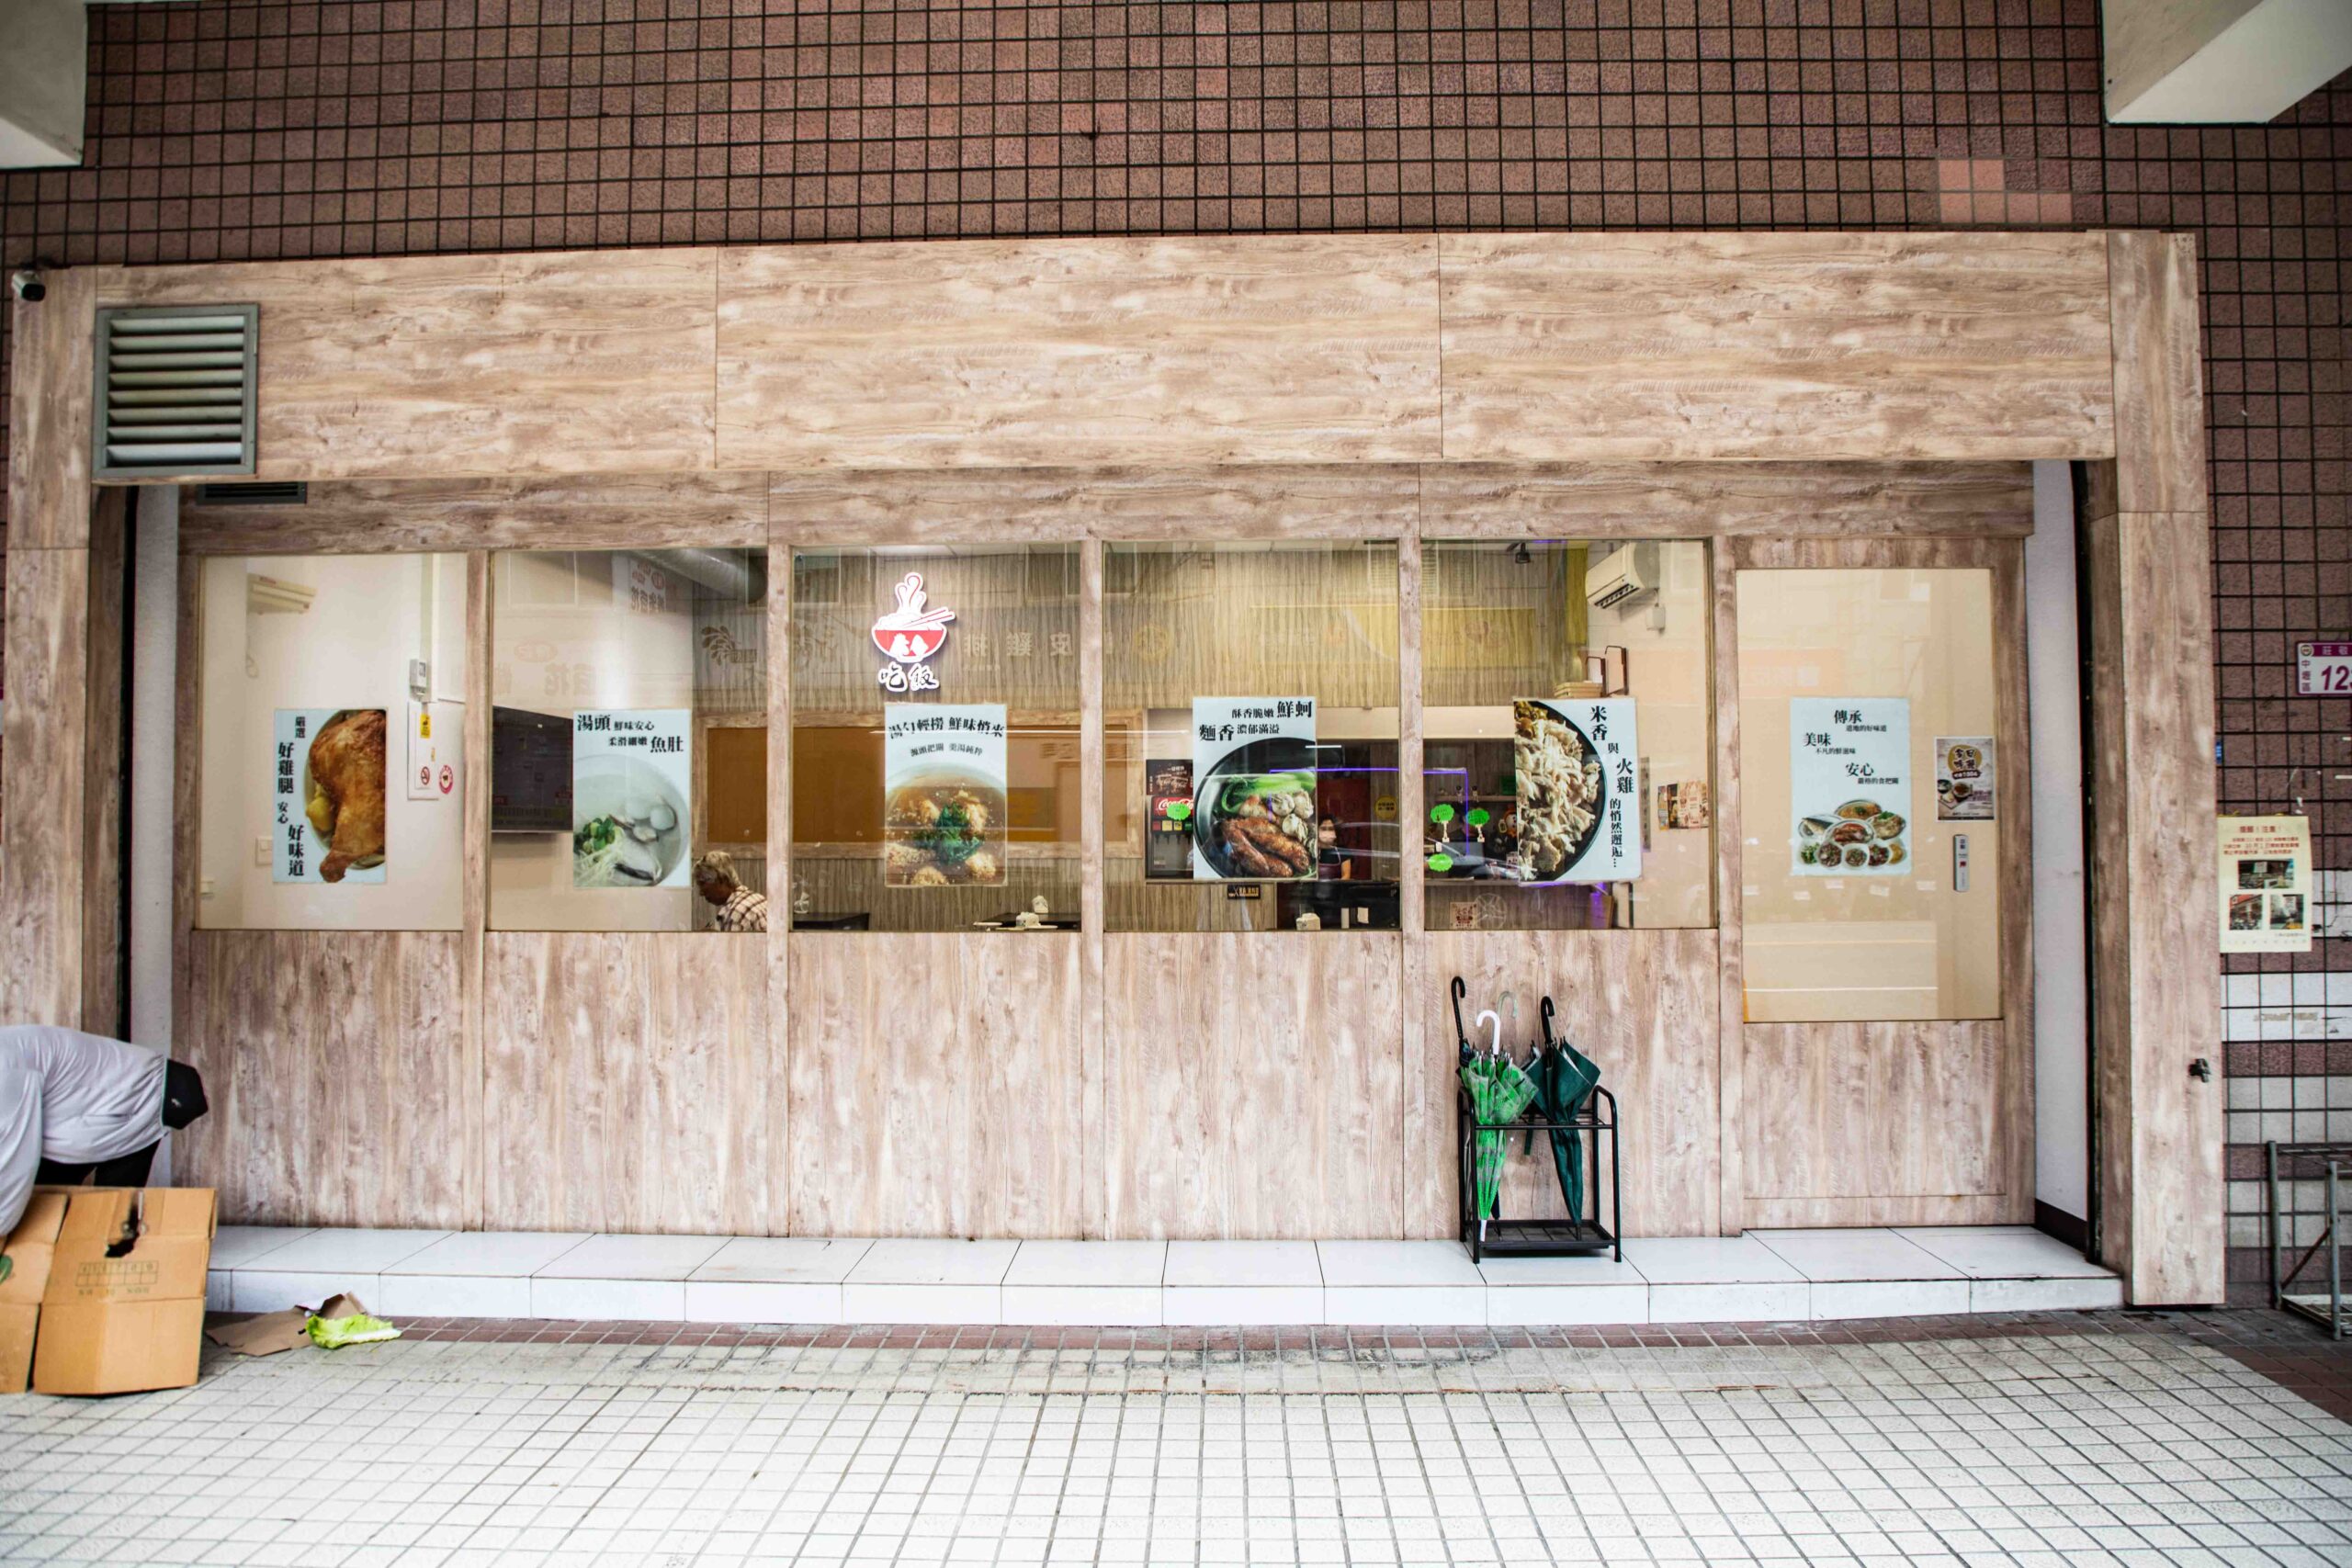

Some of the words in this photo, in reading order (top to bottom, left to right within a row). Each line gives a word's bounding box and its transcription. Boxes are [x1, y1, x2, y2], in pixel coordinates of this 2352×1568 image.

[2321, 665, 2352, 691] 12
[1232, 708, 1274, 718] 酥香脆嫩
[1277, 701, 1313, 718] 鮮蚵
[1834, 709, 1862, 724] 傳承
[577, 715, 611, 731] 湯頭
[614, 721, 655, 731] 鮮味安心
[1590, 705, 1608, 741] 米香
[1199, 724, 1235, 741] 麵香
[1237, 724, 1280, 735] 濃郁滿溢
[1804, 732, 1831, 747] 美味
[650, 736, 684, 753] 魚肚
[1608, 742, 1619, 754] 與
[278, 742, 294, 794] 好雞腿
[1616, 758, 1634, 794] 火雞
[1845, 762, 1874, 777] 安心
[278, 802, 288, 824] 安心
[288, 825, 304, 876] 好味道
